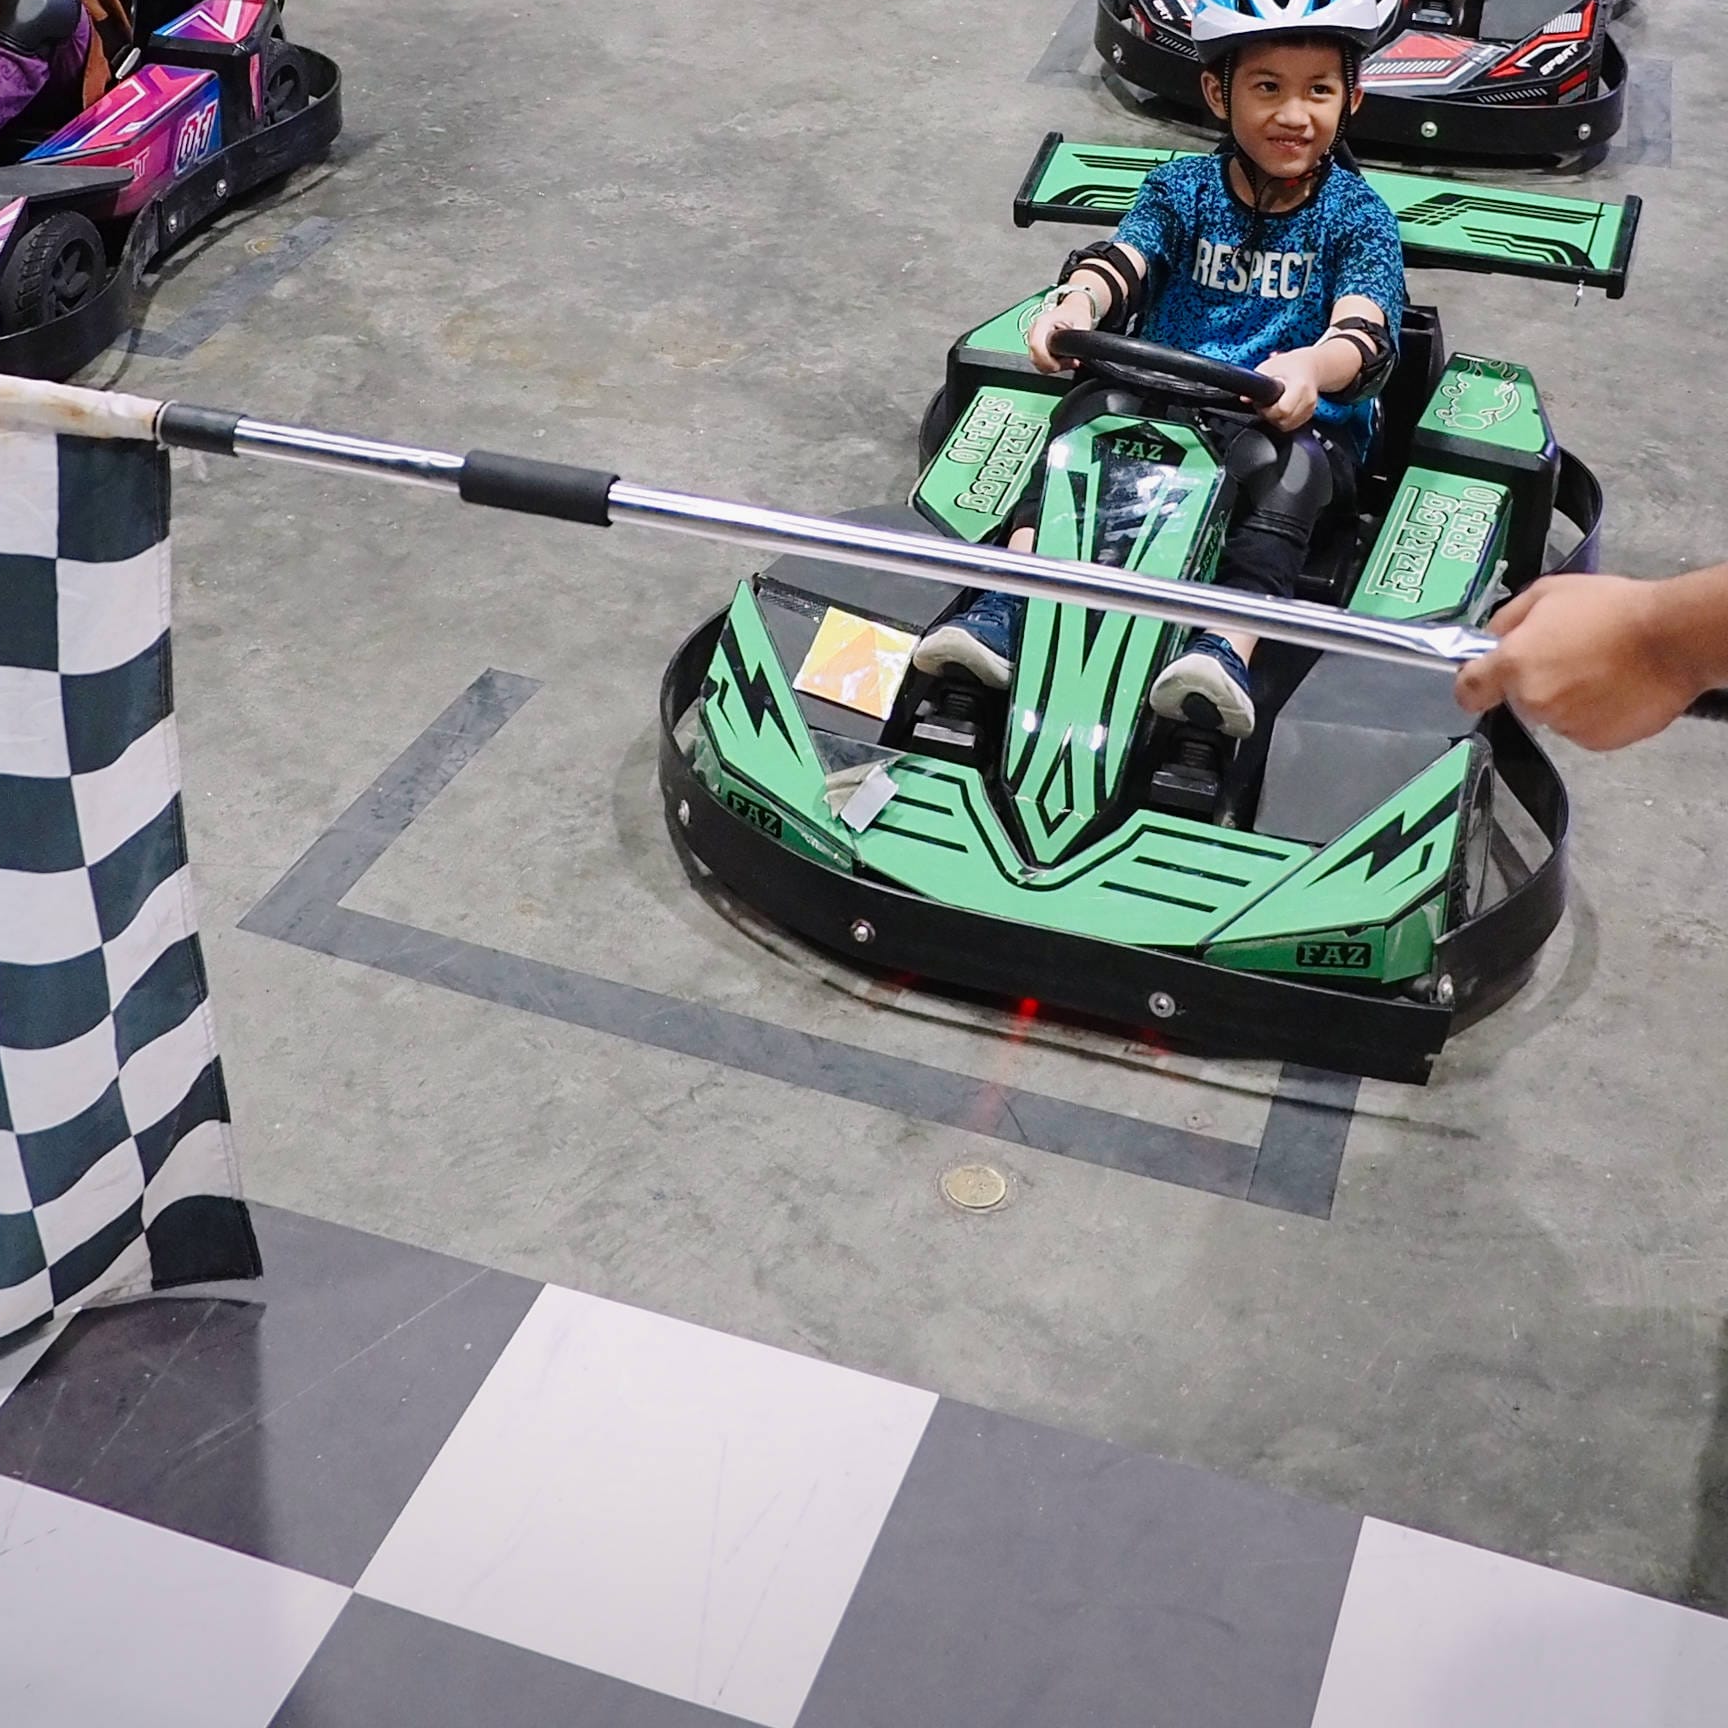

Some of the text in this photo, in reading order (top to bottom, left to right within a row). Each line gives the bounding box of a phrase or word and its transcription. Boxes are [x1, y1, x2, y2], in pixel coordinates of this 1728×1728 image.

[1539, 42, 1579, 76] SPORT
[1191, 236, 1318, 300] RESPECT
[1110, 436, 1166, 462] FAZ
[731, 793, 780, 836] FAZ
[1301, 943, 1367, 967] FAZ
